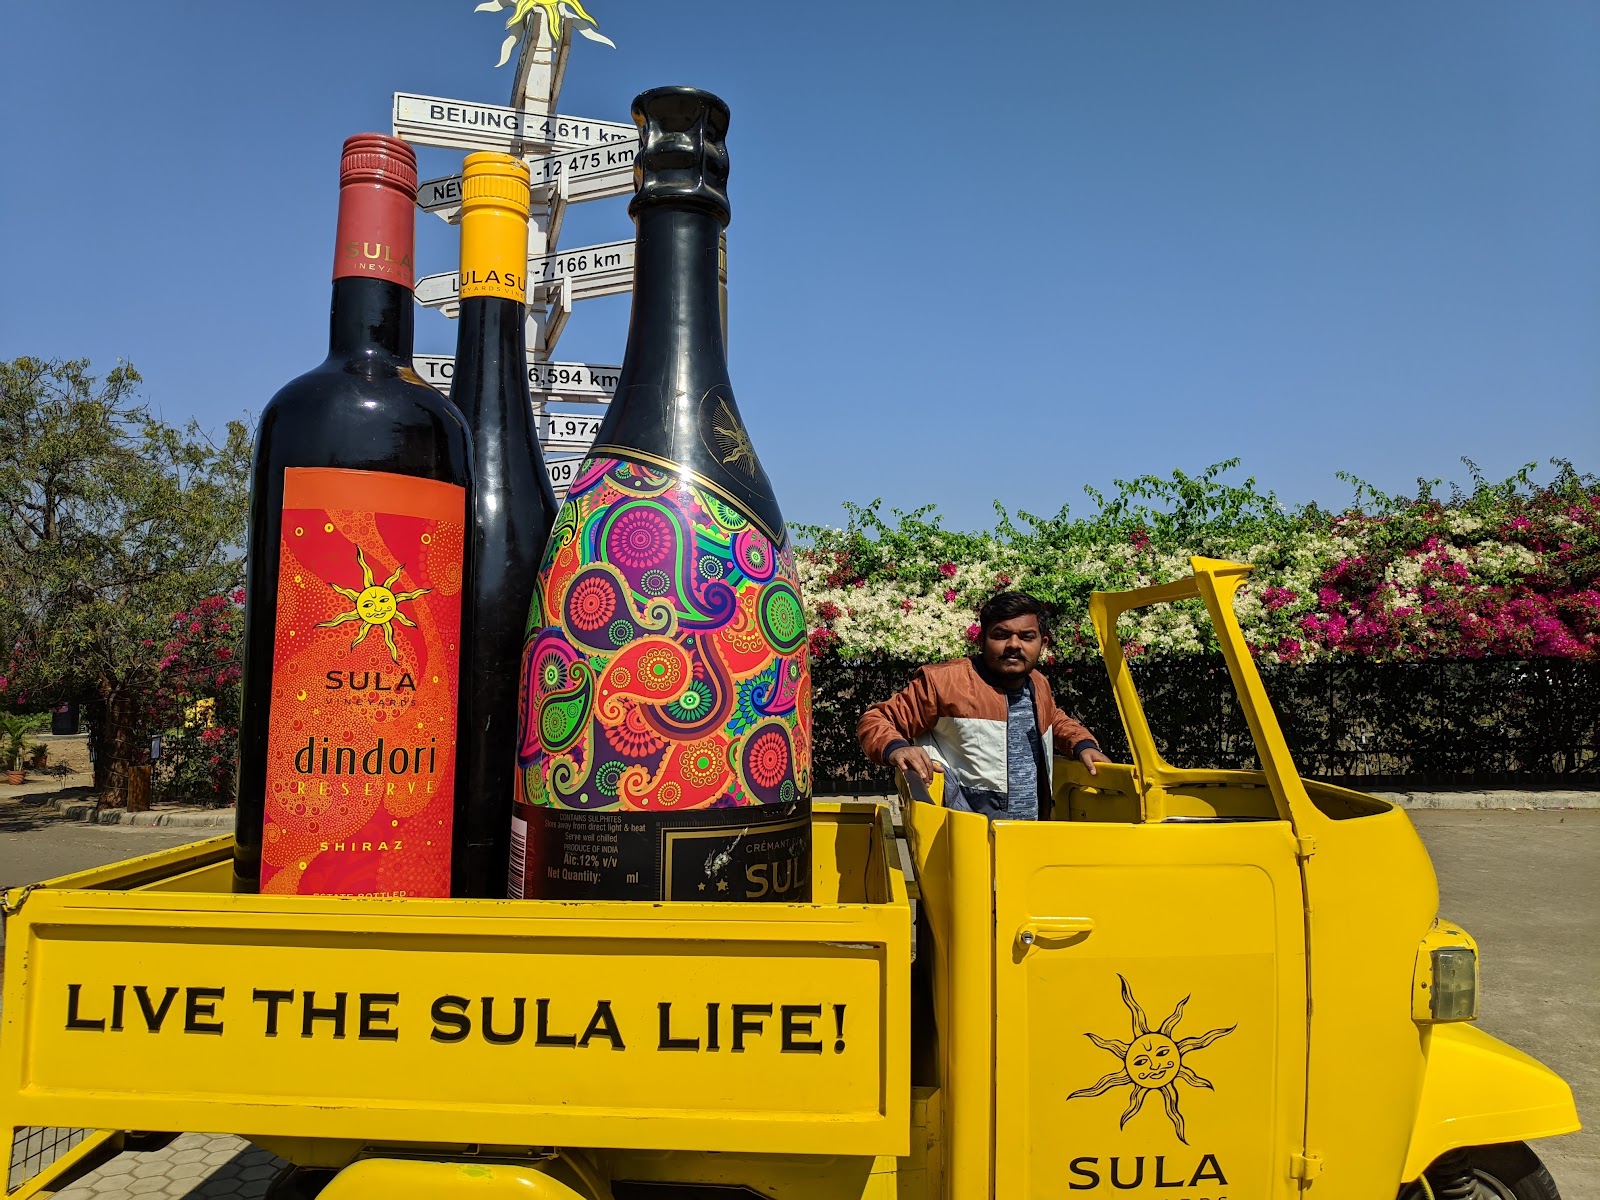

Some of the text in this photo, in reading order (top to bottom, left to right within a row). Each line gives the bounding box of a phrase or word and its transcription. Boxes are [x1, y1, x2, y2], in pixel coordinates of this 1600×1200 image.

[430, 105, 519, 130] BEIJING
[539, 123, 590, 141] 4,611
[536, 152, 601, 177] -12475
[607, 149, 634, 165] km
[344, 241, 413, 272] SULA
[594, 253, 621, 269] km
[528, 368, 583, 385] 6,594
[590, 370, 619, 387] km
[546, 464, 571, 481] 09
[325, 670, 417, 691] SULA
[325, 698, 417, 707] VINEYARDS
[294, 736, 436, 775] dindori
[297, 780, 435, 796] RESERVE
[544, 819, 646, 833] Store away from direct light & heat
[559, 813, 622, 823] CONTAINS SULPHITES
[565, 831, 618, 842] Serve well chilled
[319, 840, 403, 852] SHIRAZ
[563, 843, 619, 854] PRODUCE OF INDIA
[745, 838, 790, 854] CRÉMANT
[602, 855, 618, 868] v/v
[547, 866, 639, 884] Net Quantity: ml
[64, 983, 848, 1055] LIVE THE SULA LIFE!
[1068, 1153, 1229, 1190] SULA
